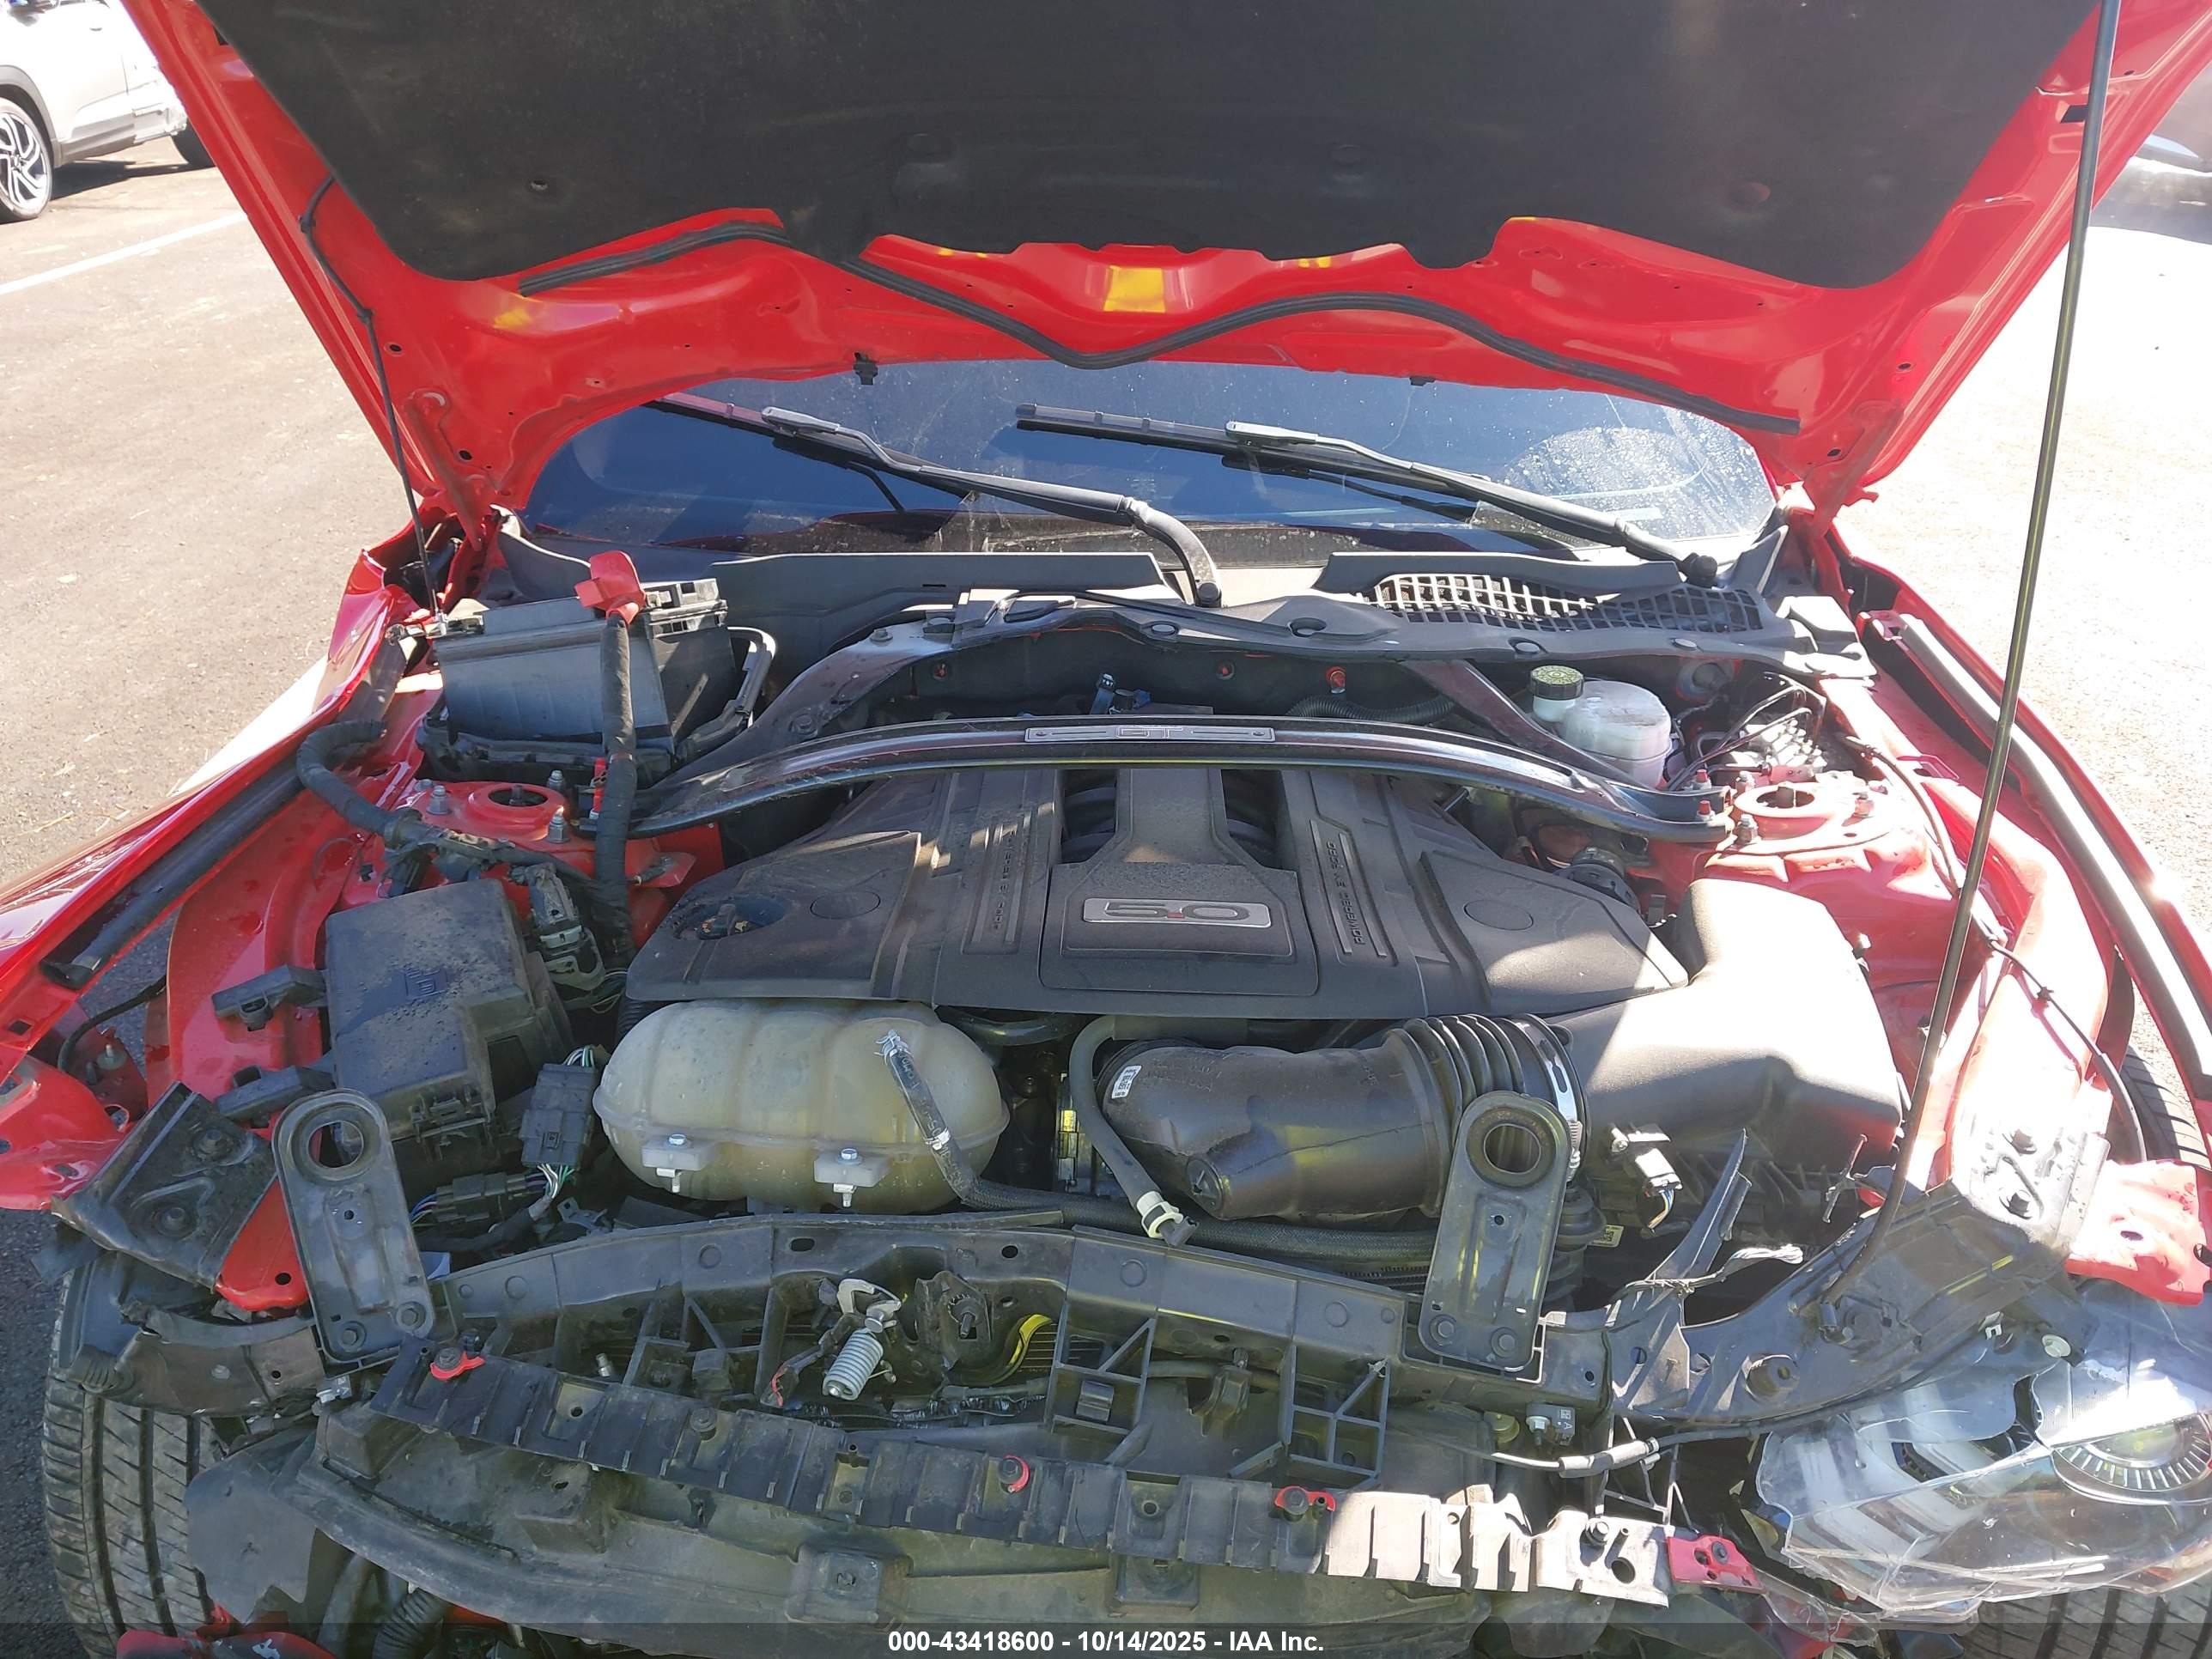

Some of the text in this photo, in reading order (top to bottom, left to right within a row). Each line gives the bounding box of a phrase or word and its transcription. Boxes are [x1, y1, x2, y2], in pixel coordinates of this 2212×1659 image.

[1116, 725, 1183, 738] GT
[1103, 901, 1250, 921] 5.0
[1340, 892, 1366, 945] POWERED
